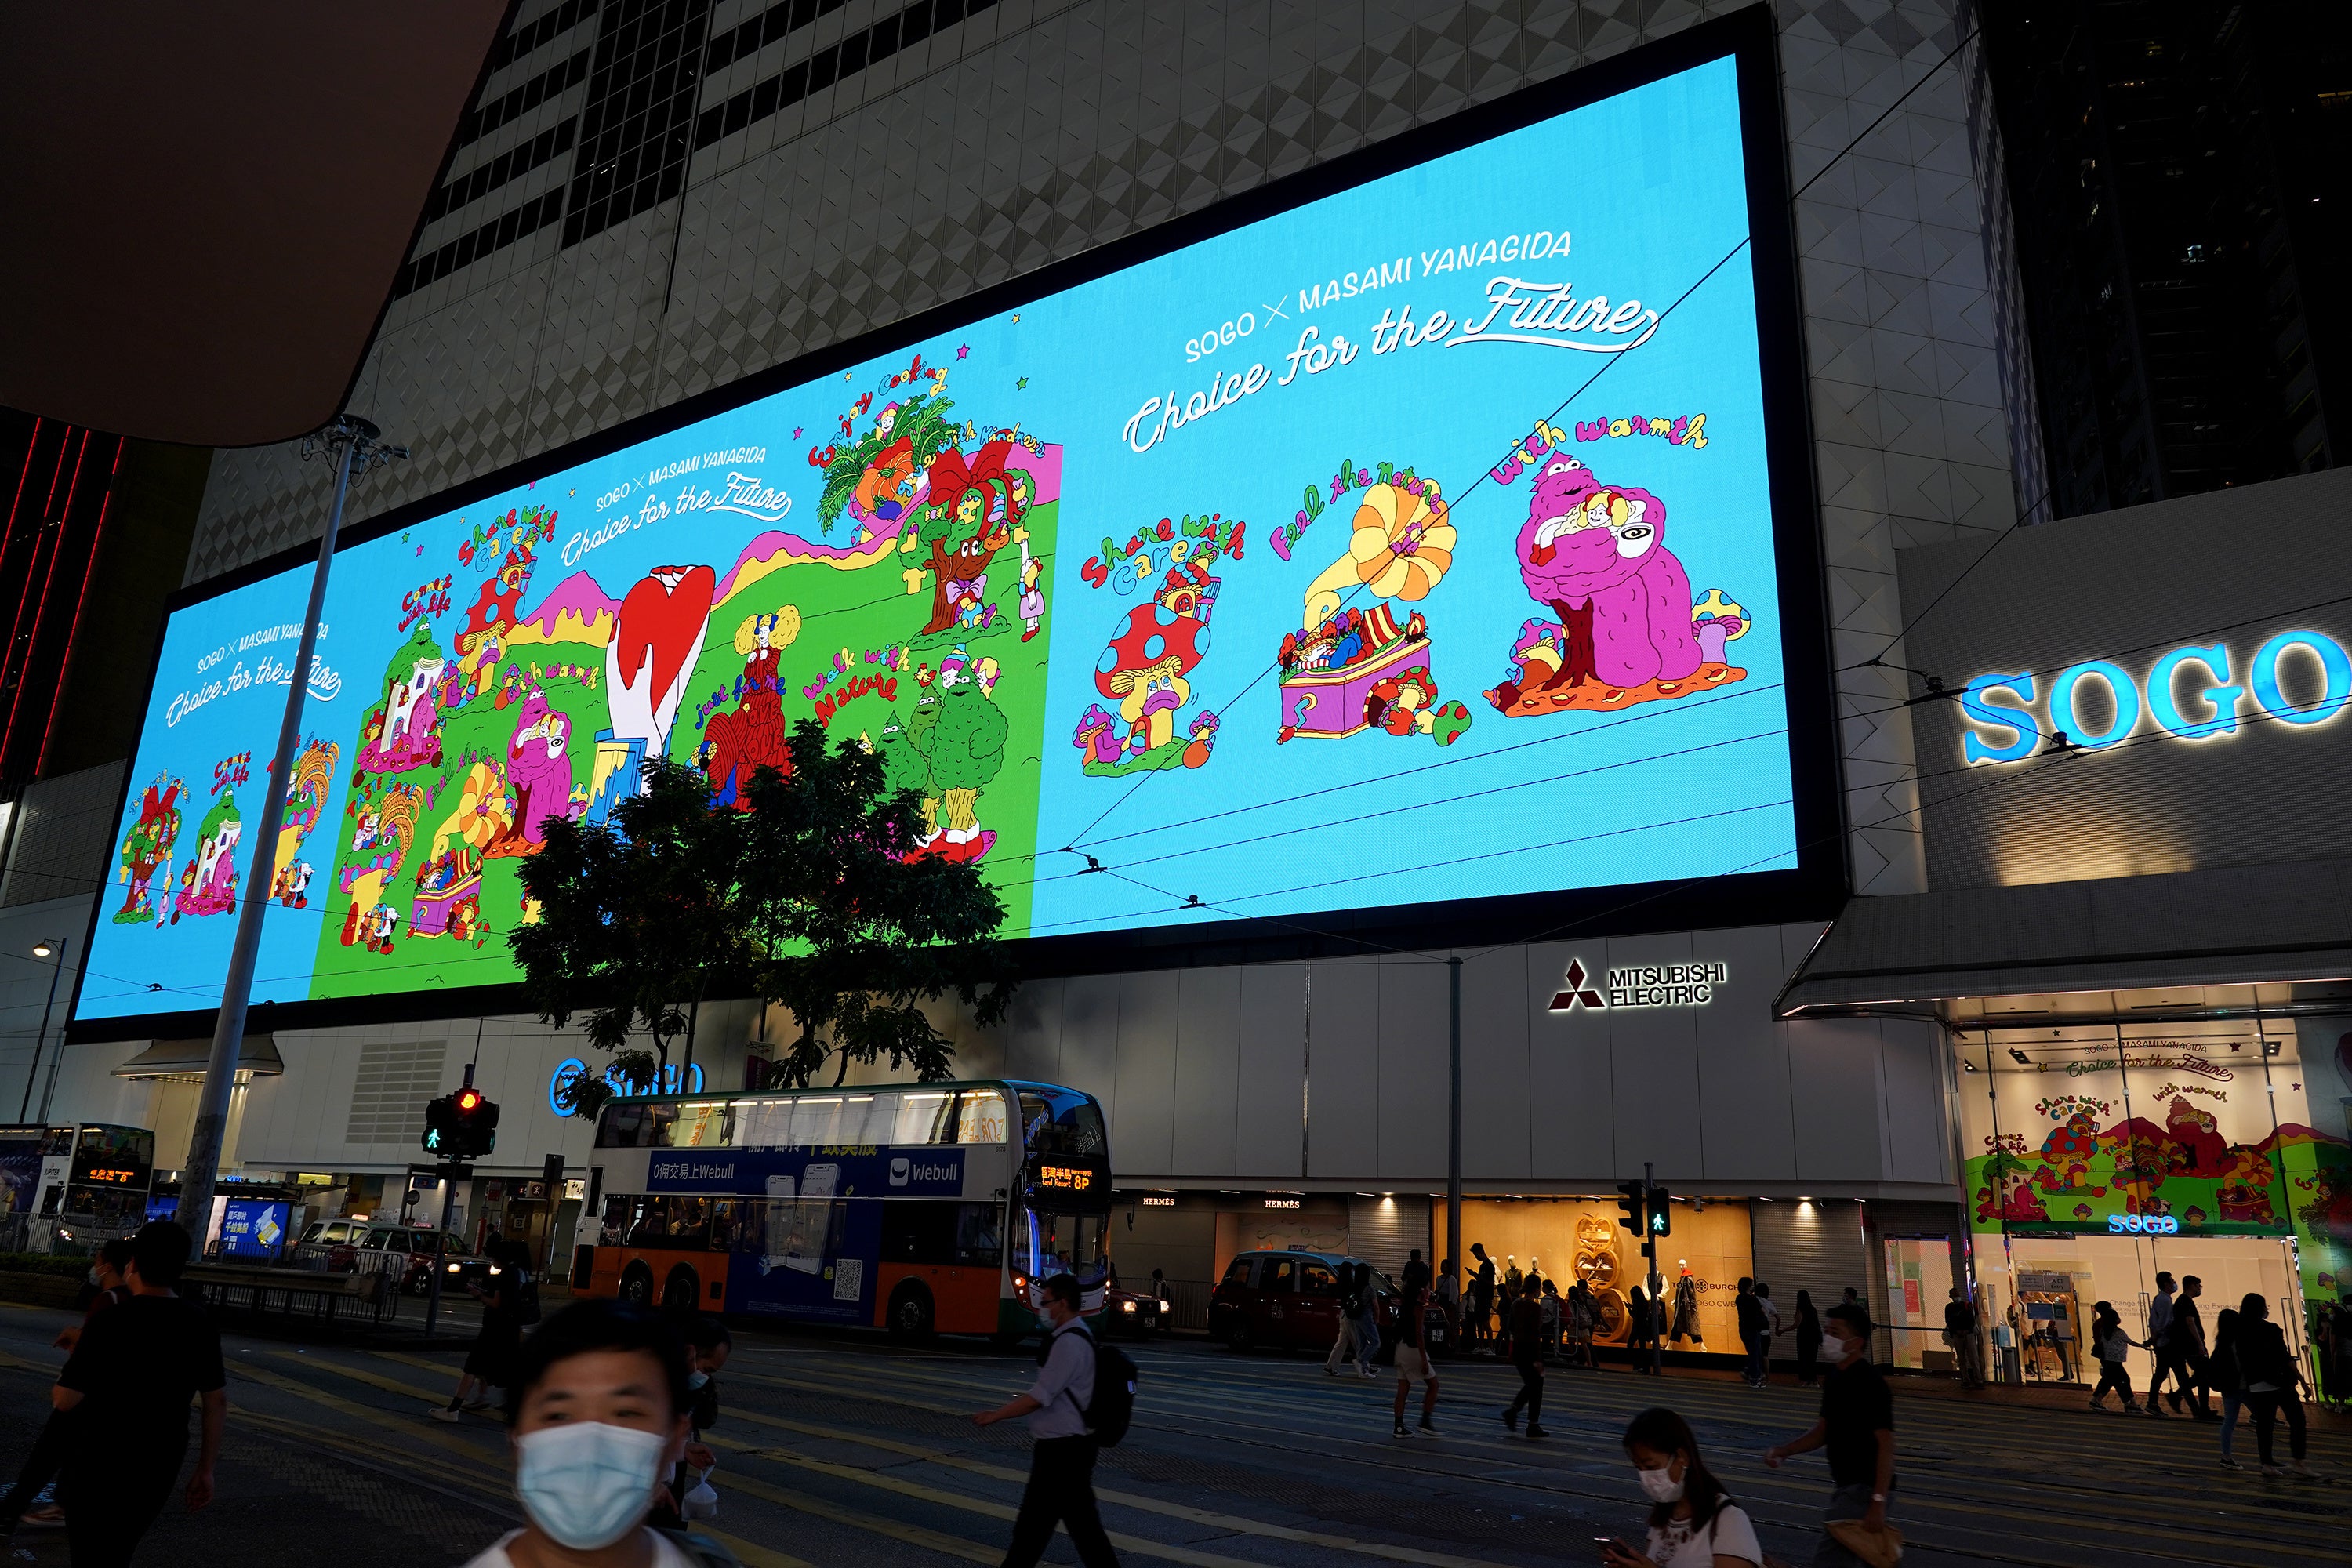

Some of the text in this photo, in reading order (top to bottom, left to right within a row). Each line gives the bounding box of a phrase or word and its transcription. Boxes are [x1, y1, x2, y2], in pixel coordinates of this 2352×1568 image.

[1185, 312, 1255, 363] SOGO
[1299, 256, 1412, 314] MASAMI
[1421, 231, 1570, 277] YANAGIDA
[1122, 275, 1660, 453] Choice for the Future
[1490, 413, 1708, 485] with warmth
[596, 482, 630, 512] SOGO
[648, 456, 700, 486] MASAMI
[702, 446, 766, 470] YANAGIDA
[1330, 459, 1373, 505] the
[458, 508, 517, 567] Share
[561, 470, 792, 567] Choice for the Future
[1080, 517, 1175, 589] Share
[398, 590, 451, 633] with life
[401, 573, 452, 612] Connect
[197, 646, 225, 674] SOGO
[238, 626, 280, 652] MASAMI
[280, 622, 328, 641] YANADA
[865, 644, 911, 672] with
[165, 680, 222, 728] Choice
[223, 660, 252, 696] for
[255, 655, 284, 685] the
[546, 662, 600, 690] warmth
[732, 674, 760, 702] for
[764, 674, 786, 696] me
[1962, 630, 2351, 764] SOGO
[347, 777, 383, 818] TASTE
[1609, 963, 1725, 988] MITSUBISHI
[1610, 984, 1710, 1007] ELECTRIC
[2065, 1053, 2234, 1082] Choice for the Future
[2085, 1044, 2108, 1055] SOGO
[2122, 1040, 2158, 1049] MASAMI
[2161, 1040, 2207, 1053] YANAGIDA
[2035, 1094, 2077, 1116] Share
[2152, 1082, 2228, 1103] with warmth
[913, 1163, 957, 1181] Webull
[1074, 1175, 1090, 1189] 8P
[2107, 1214, 2180, 1234] SOGO
